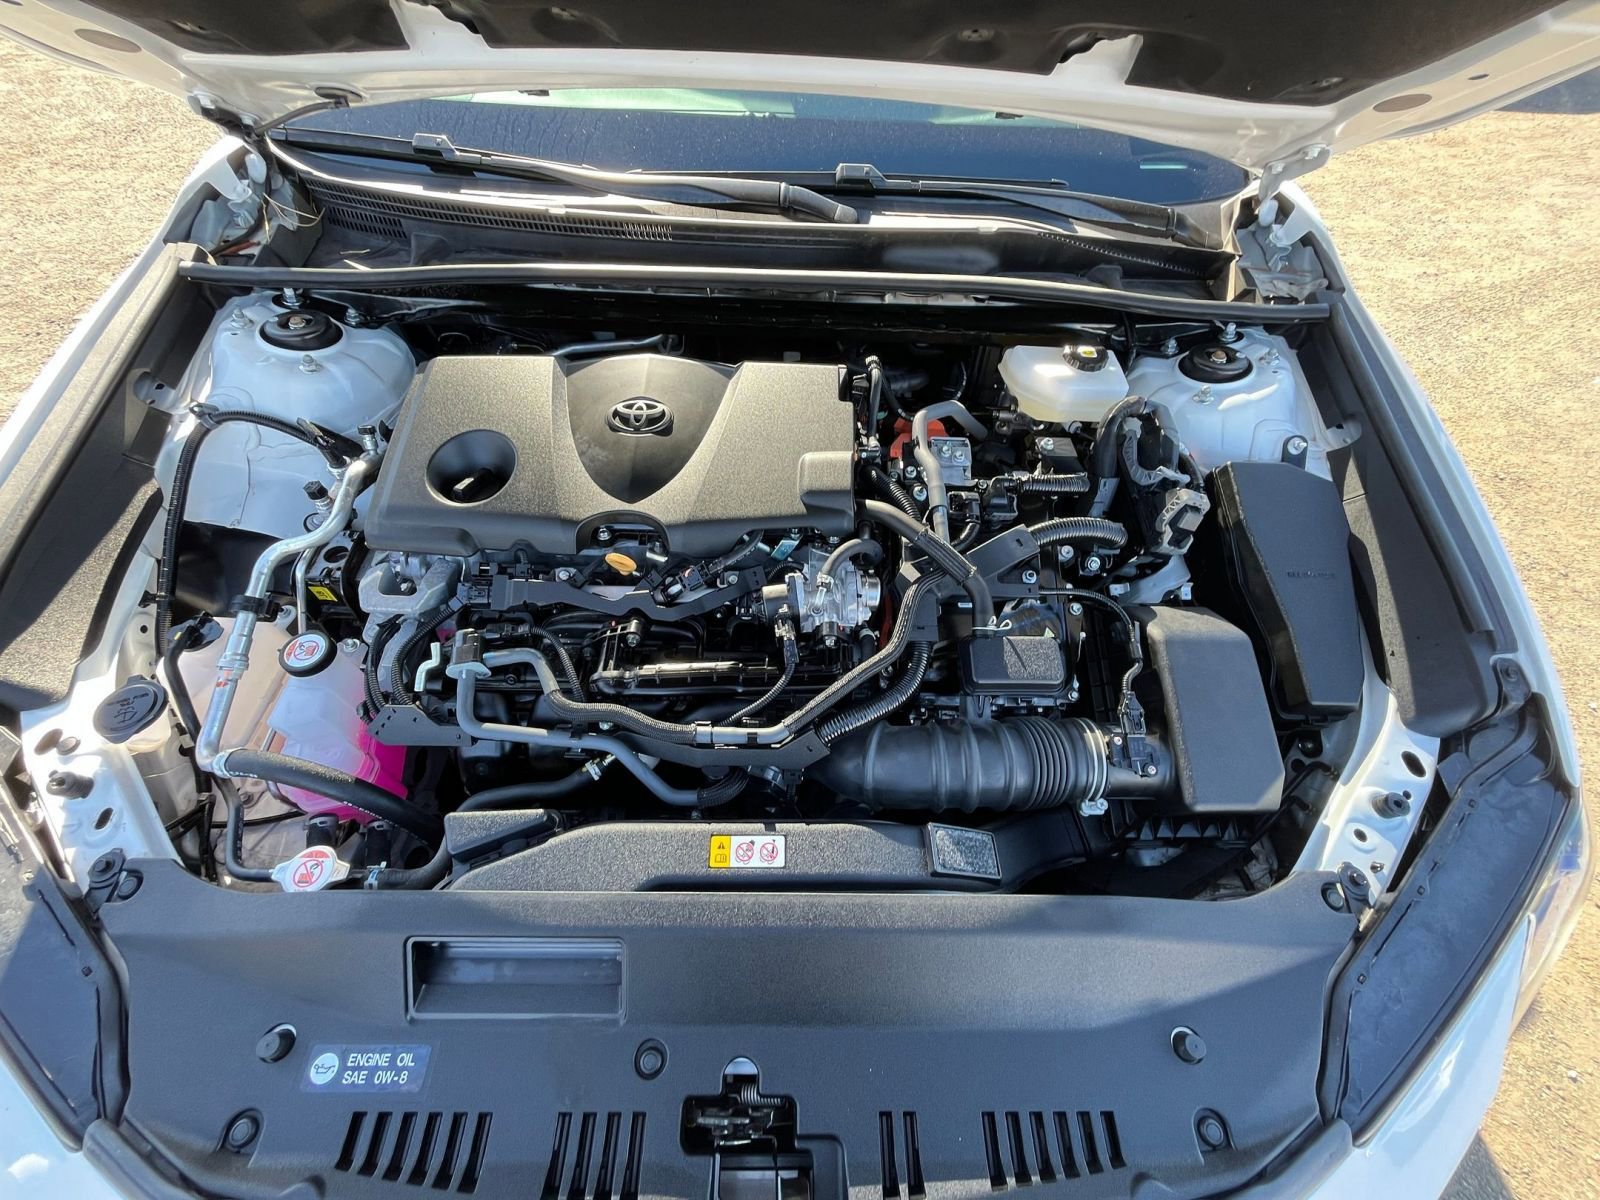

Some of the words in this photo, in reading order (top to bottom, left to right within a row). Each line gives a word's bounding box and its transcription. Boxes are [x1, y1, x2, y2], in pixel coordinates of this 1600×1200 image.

[347, 1053, 391, 1066] ENGINE
[397, 1053, 415, 1066] OIL
[342, 1071, 368, 1084] SAE
[374, 1070, 408, 1084] 0W-8
